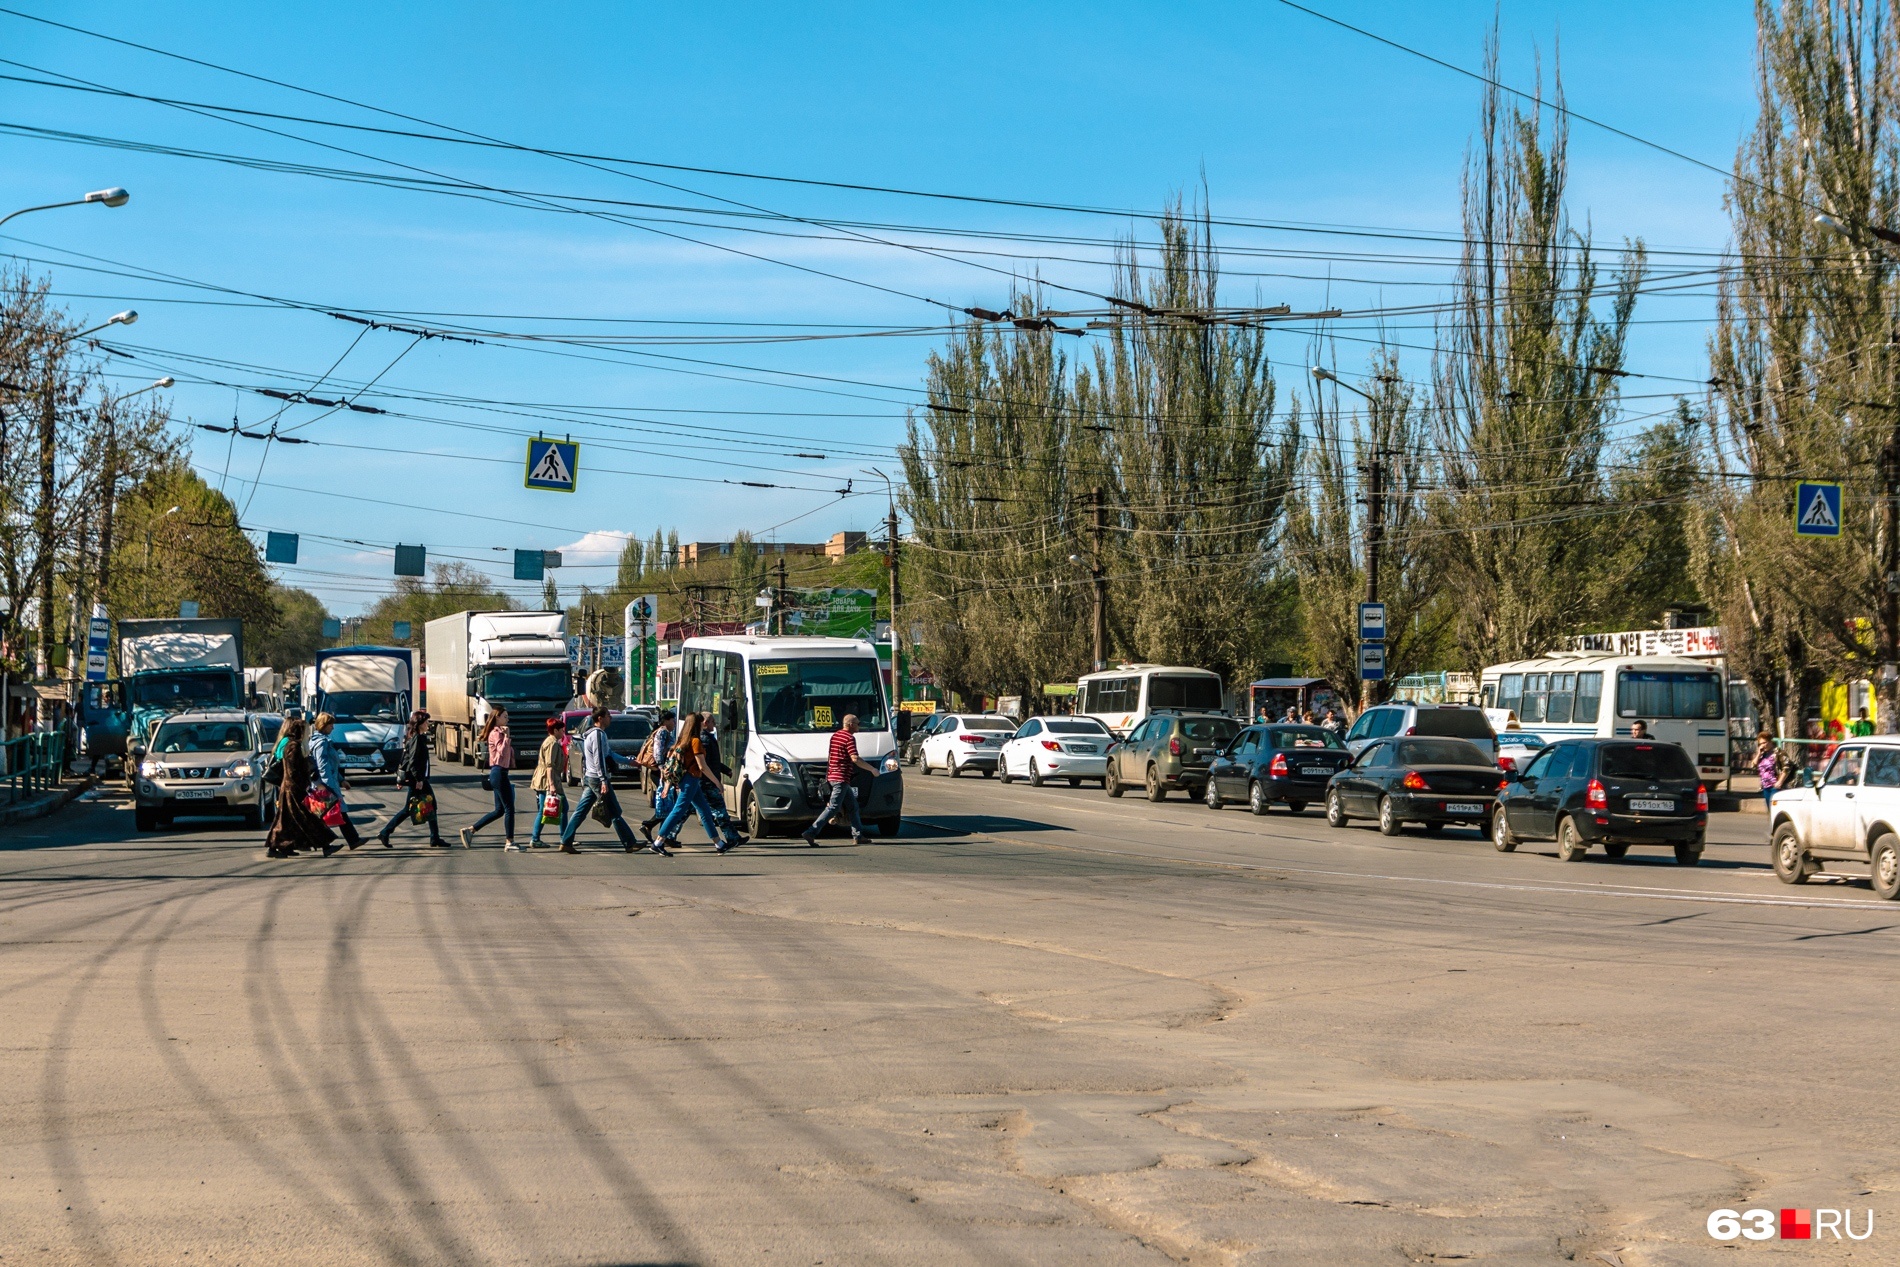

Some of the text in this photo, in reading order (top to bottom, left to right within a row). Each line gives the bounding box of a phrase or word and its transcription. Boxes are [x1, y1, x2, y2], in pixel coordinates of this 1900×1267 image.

[832, 597, 857, 605] ТОВАРЫ
[832, 605, 862, 613] ДЛЯ ДАЧИ
[1687, 631, 1700, 652] 24
[816, 709, 831, 723] 266
